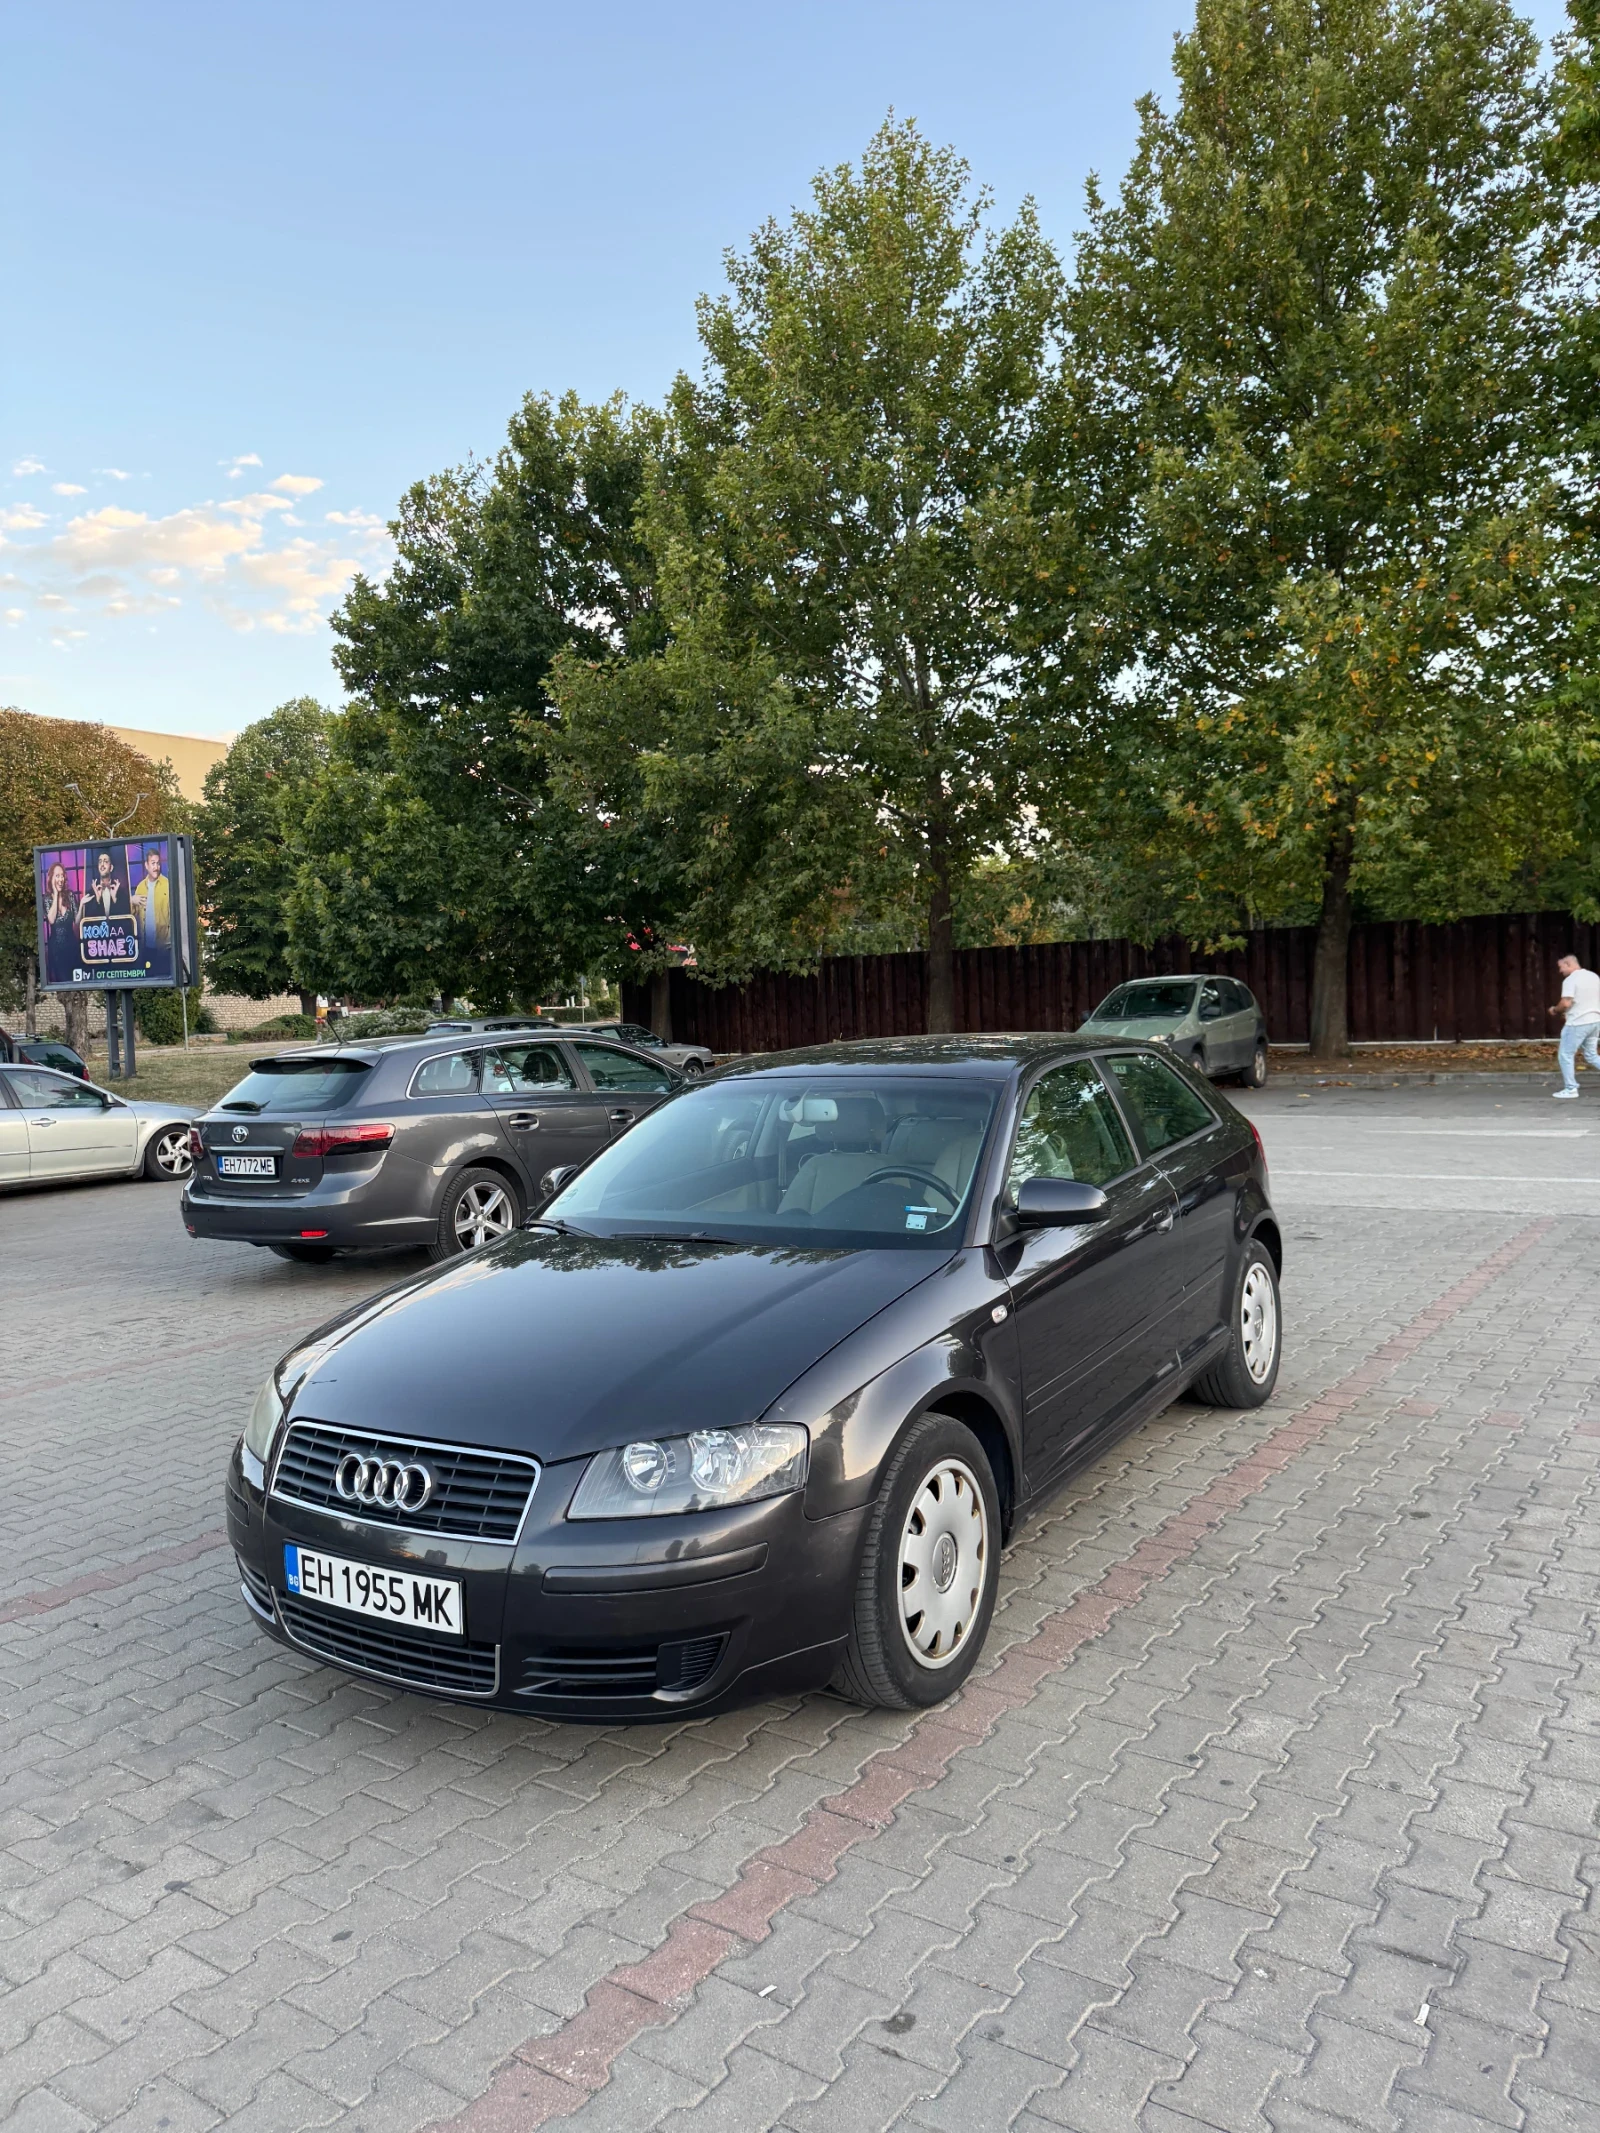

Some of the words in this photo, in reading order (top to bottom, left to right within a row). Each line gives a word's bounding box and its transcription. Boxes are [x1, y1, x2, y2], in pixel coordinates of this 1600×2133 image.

[83, 921, 109, 938] КОЙ
[110, 927, 124, 937] ДА
[87, 935, 135, 957] ЗНАЕ?
[96, 970, 106, 979] ОТ
[106, 969, 146, 979] СЕПТЕМВРИ
[288, 1573, 299, 1587] BG
[301, 1554, 334, 1599] EH
[342, 1565, 406, 1616] 1955
[413, 1581, 453, 1627] MK
